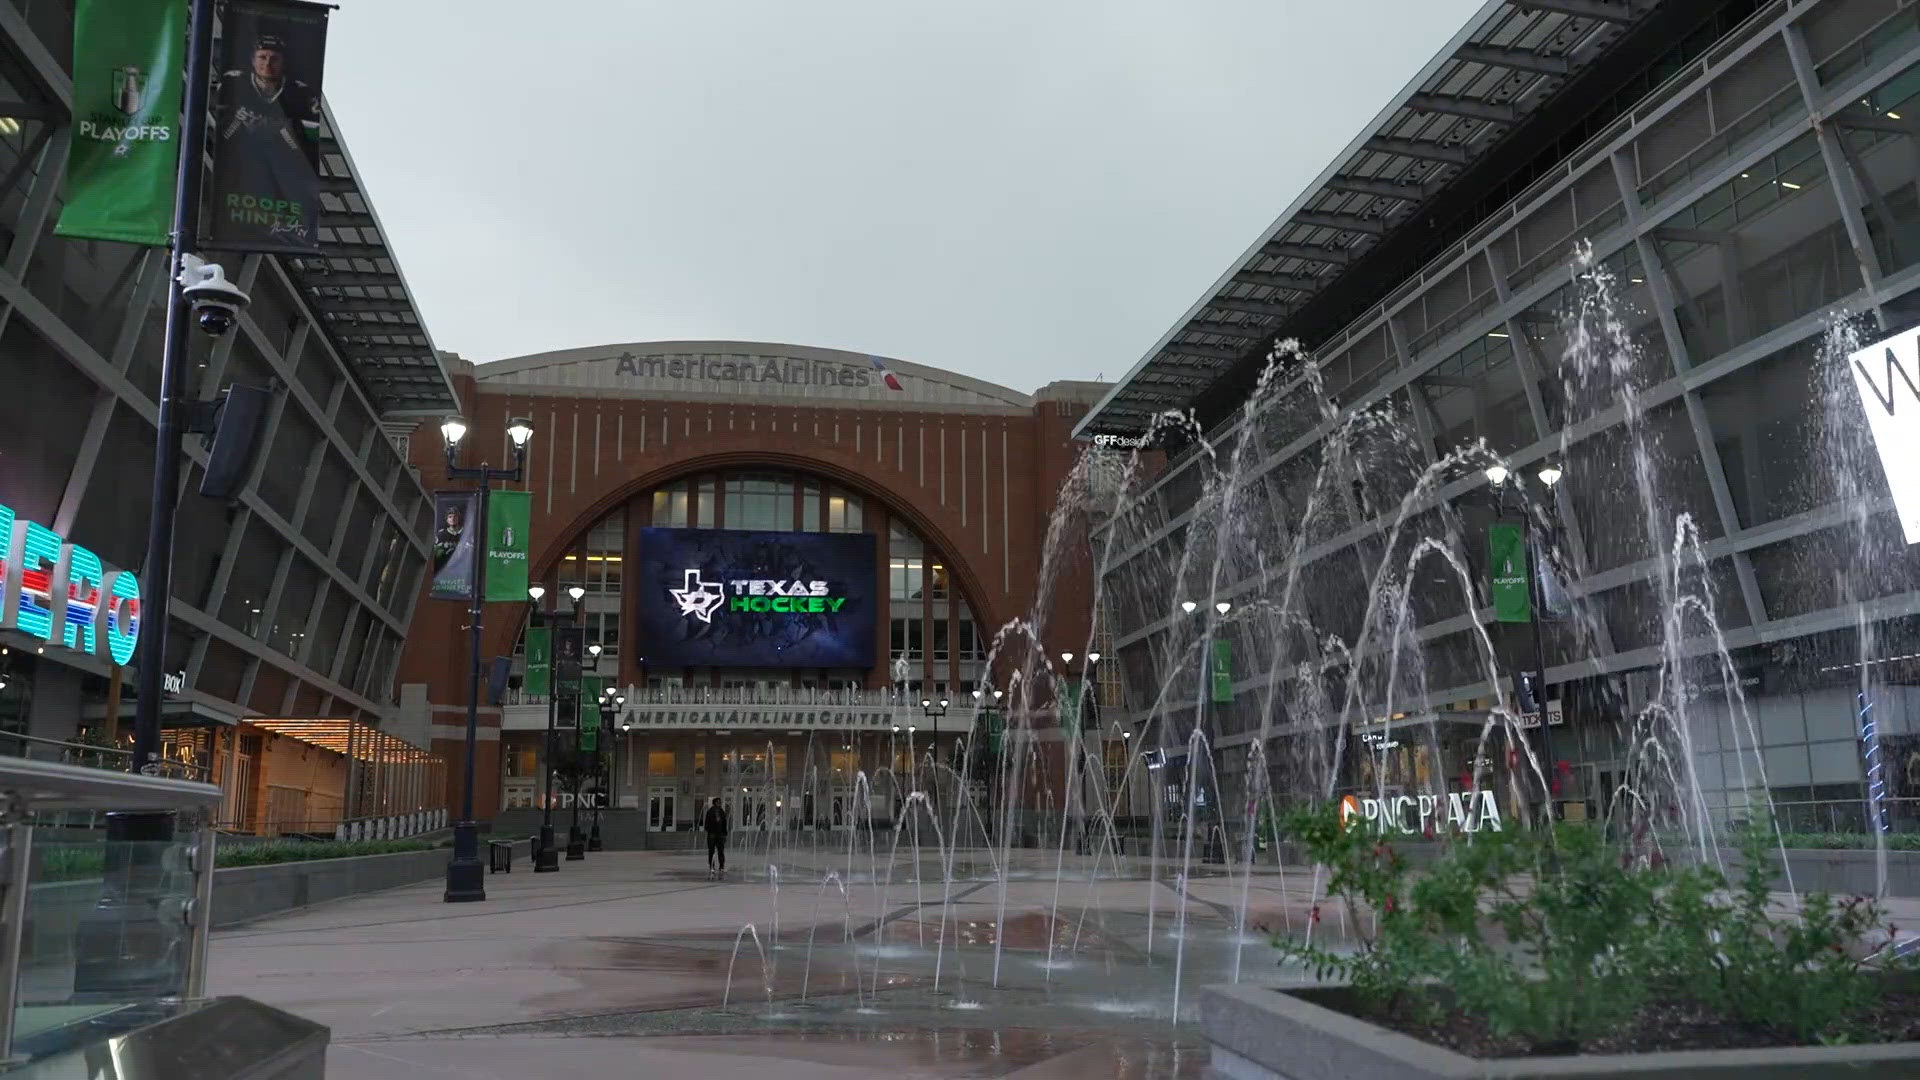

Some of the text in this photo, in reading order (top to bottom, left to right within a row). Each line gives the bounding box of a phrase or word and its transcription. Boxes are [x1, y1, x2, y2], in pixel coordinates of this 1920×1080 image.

[79, 120, 171, 141] PLAYOFFS
[226, 192, 302, 216] ROOPE
[231, 208, 299, 228] HINTZ
[489, 550, 526, 560] PLAYOFFS
[730, 579, 829, 596] TEXAS
[1493, 577, 1525, 585] PLAYOFFS
[730, 597, 846, 613] HOCKEY
[1521, 710, 1562, 726] TICKTS
